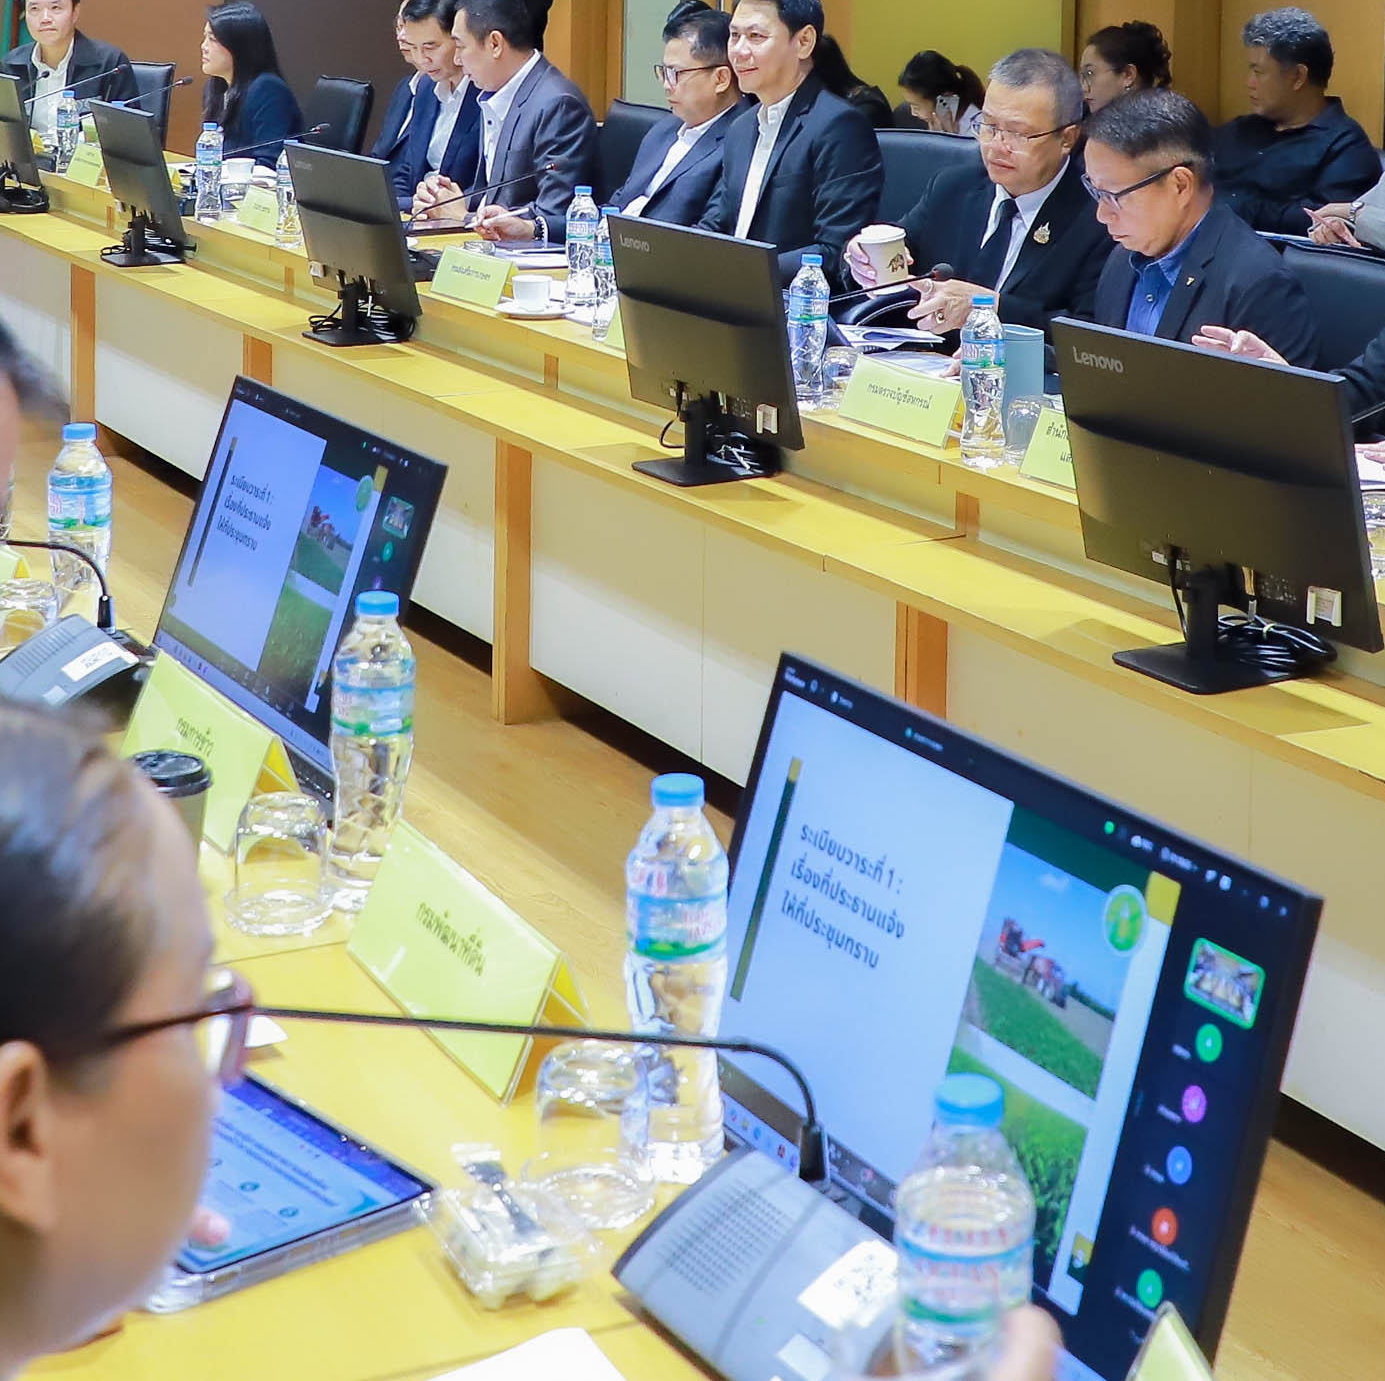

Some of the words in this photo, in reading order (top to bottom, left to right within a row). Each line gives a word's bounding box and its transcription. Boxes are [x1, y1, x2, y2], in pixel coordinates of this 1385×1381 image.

[619, 233, 650, 253] Lenovo
[1072, 345, 1124, 374] Lenovo
[800, 824, 887, 883] ระเบียบวาระที่
[790, 851, 905, 939] เรื่องที่ประธานแจ้ง
[781, 889, 880, 969] ให้ที่ประชุมทราบ
